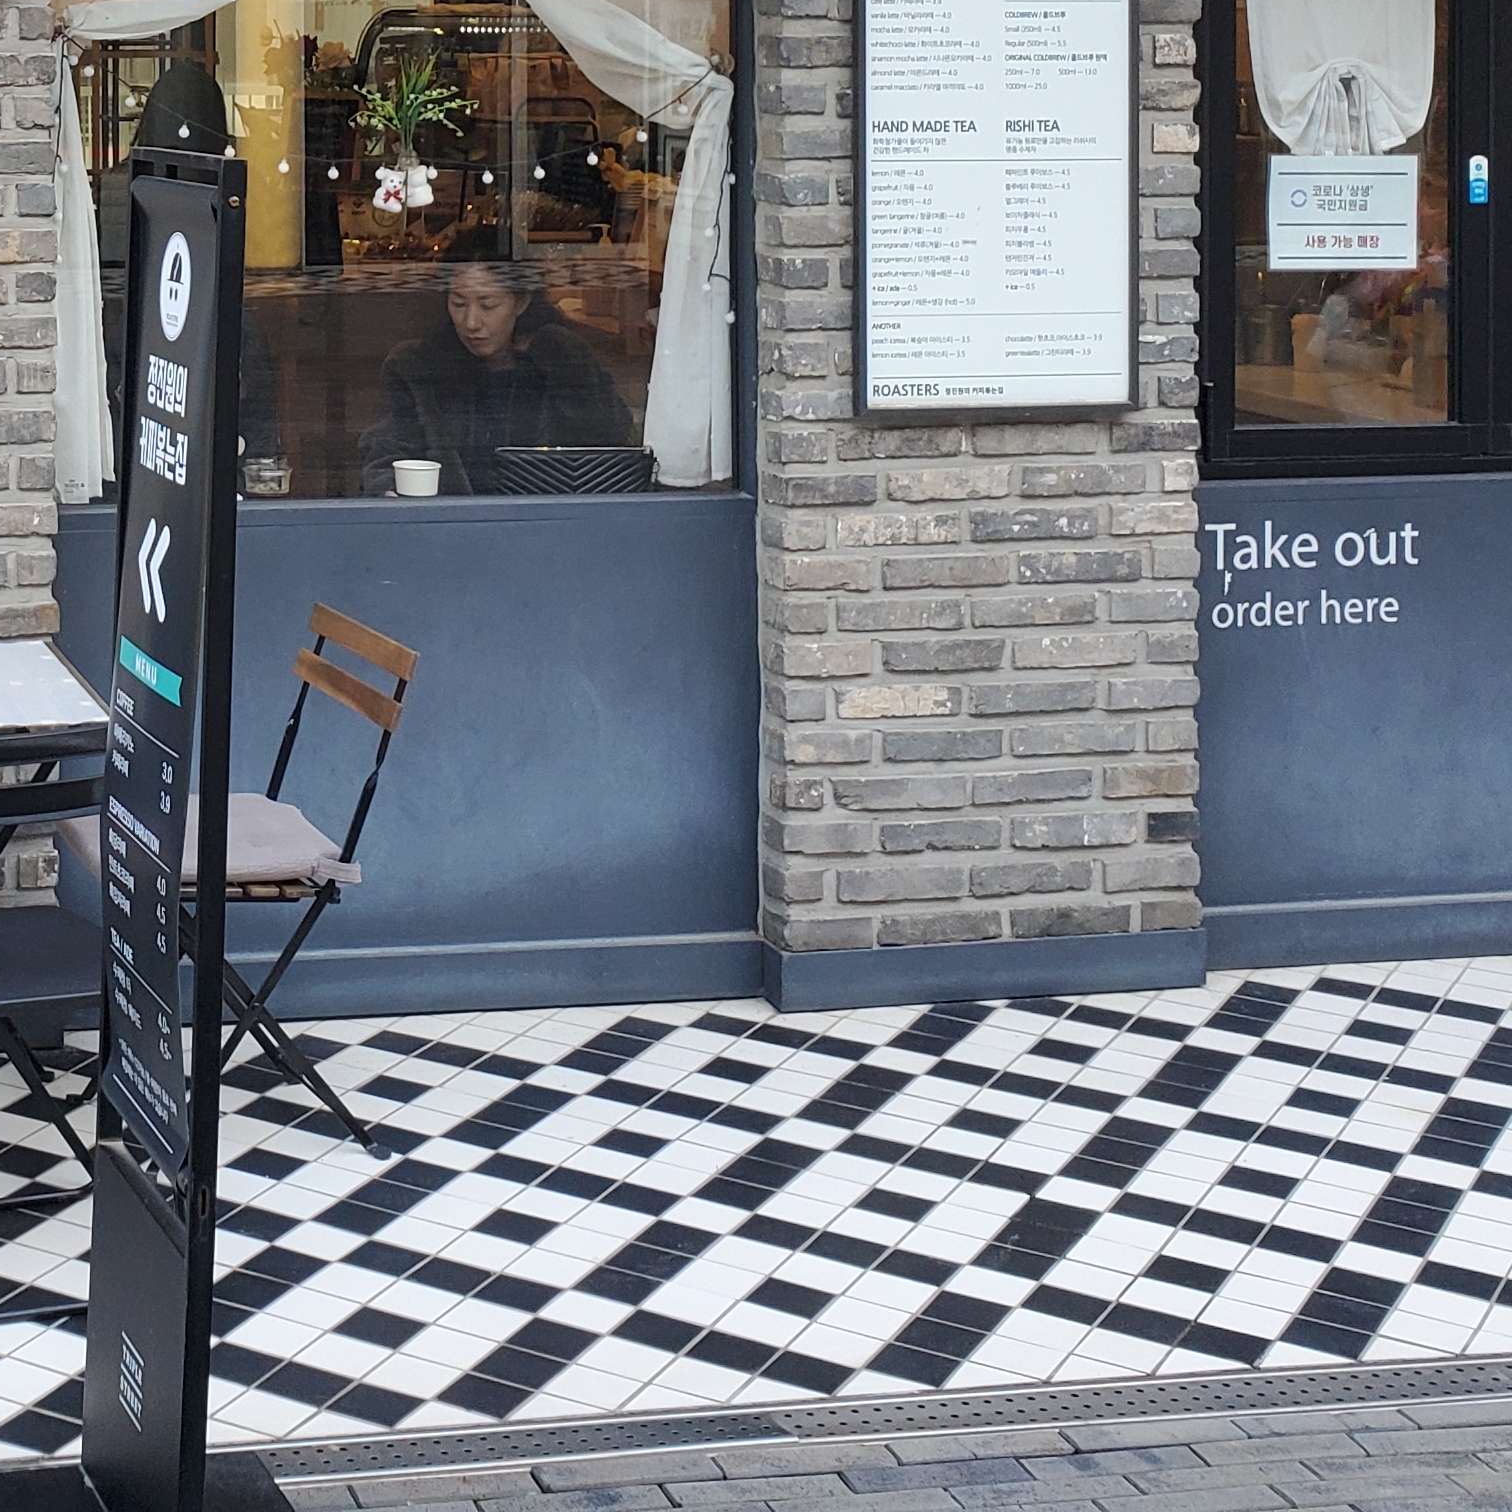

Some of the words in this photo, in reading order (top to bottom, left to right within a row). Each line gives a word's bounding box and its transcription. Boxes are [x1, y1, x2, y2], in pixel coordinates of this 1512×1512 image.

[970, 40, 980, 48] 4.0
[1004, 53, 1032, 61] ORIGINAL
[1033, 53, 1067, 61] COLDBREW
[947, 69, 957, 77] 4.0
[1004, 68, 1023, 76] 250ml
[1031, 68, 1040, 76] 7.0
[1058, 68, 1076, 76] 500ml
[974, 83, 984, 91] 4.0
[872, 120, 908, 133] HAND
[912, 120, 950, 133] MADE
[953, 120, 977, 133] TEA
[1005, 120, 1034, 133] RISHI
[1037, 120, 1060, 133] TEA
[914, 169, 924, 177] 4.0
[923, 184, 933, 192] 4.0
[1311, 184, 1344, 198] 코로나
[922, 198, 932, 206] 4.0
[1037, 197, 1046, 205] 4.5
[1316, 199, 1368, 212] 국민지원금
[955, 212, 965, 221] 4.0
[1048, 211, 1058, 219] 4.5
[932, 227, 942, 235] 4.0
[949, 241, 959, 250] 4.0
[1304, 234, 1327, 249] 사용
[1331, 234, 1353, 249] 가능
[1357, 234, 1380, 249] 매장
[1042, 254, 1051, 262] 4.5
[960, 270, 970, 278] 4.0
[1055, 268, 1065, 276] 4.5
[966, 298, 976, 306] 5.0
[147, 354, 188, 418] 정진원의
[872, 384, 940, 397] ROASTERS
[139, 415, 188, 486] 커피볶는집
[1204, 520, 1319, 570] Take
[1335, 522, 1419, 567] out
[1212, 591, 1310, 629] order
[1320, 589, 1400, 624] here
[135, 653, 158, 686] MENU
[161, 761, 173, 784] 3.0
[160, 790, 171, 815] 3.9
